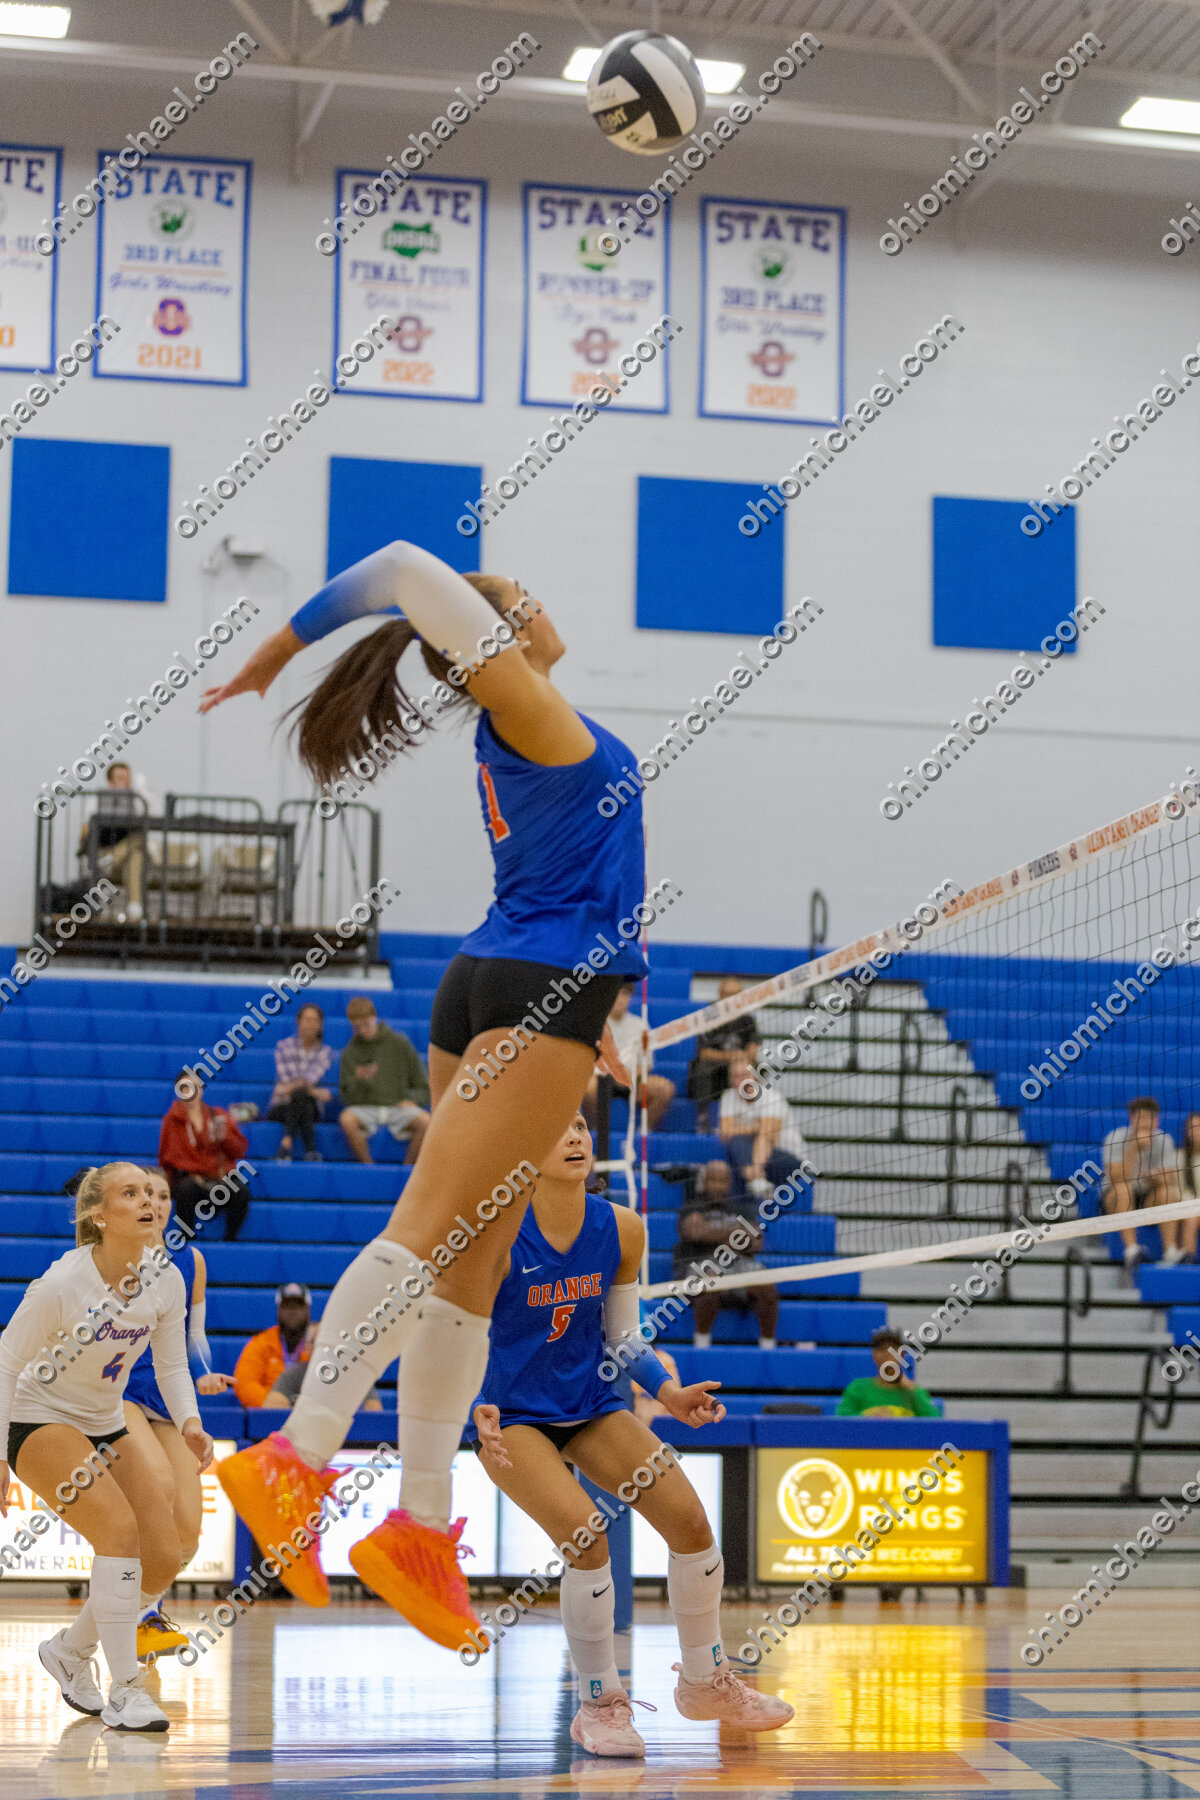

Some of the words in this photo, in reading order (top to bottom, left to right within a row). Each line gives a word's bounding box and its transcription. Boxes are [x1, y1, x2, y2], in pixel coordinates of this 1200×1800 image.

[715, 210, 831, 253] STATE
[138, 343, 202, 370] 2021
[527, 1272, 602, 1307] ORANGE
[95, 1321, 151, 1346] Orange
[546, 1304, 578, 1342] 5
[101, 1351, 127, 1383] 4
